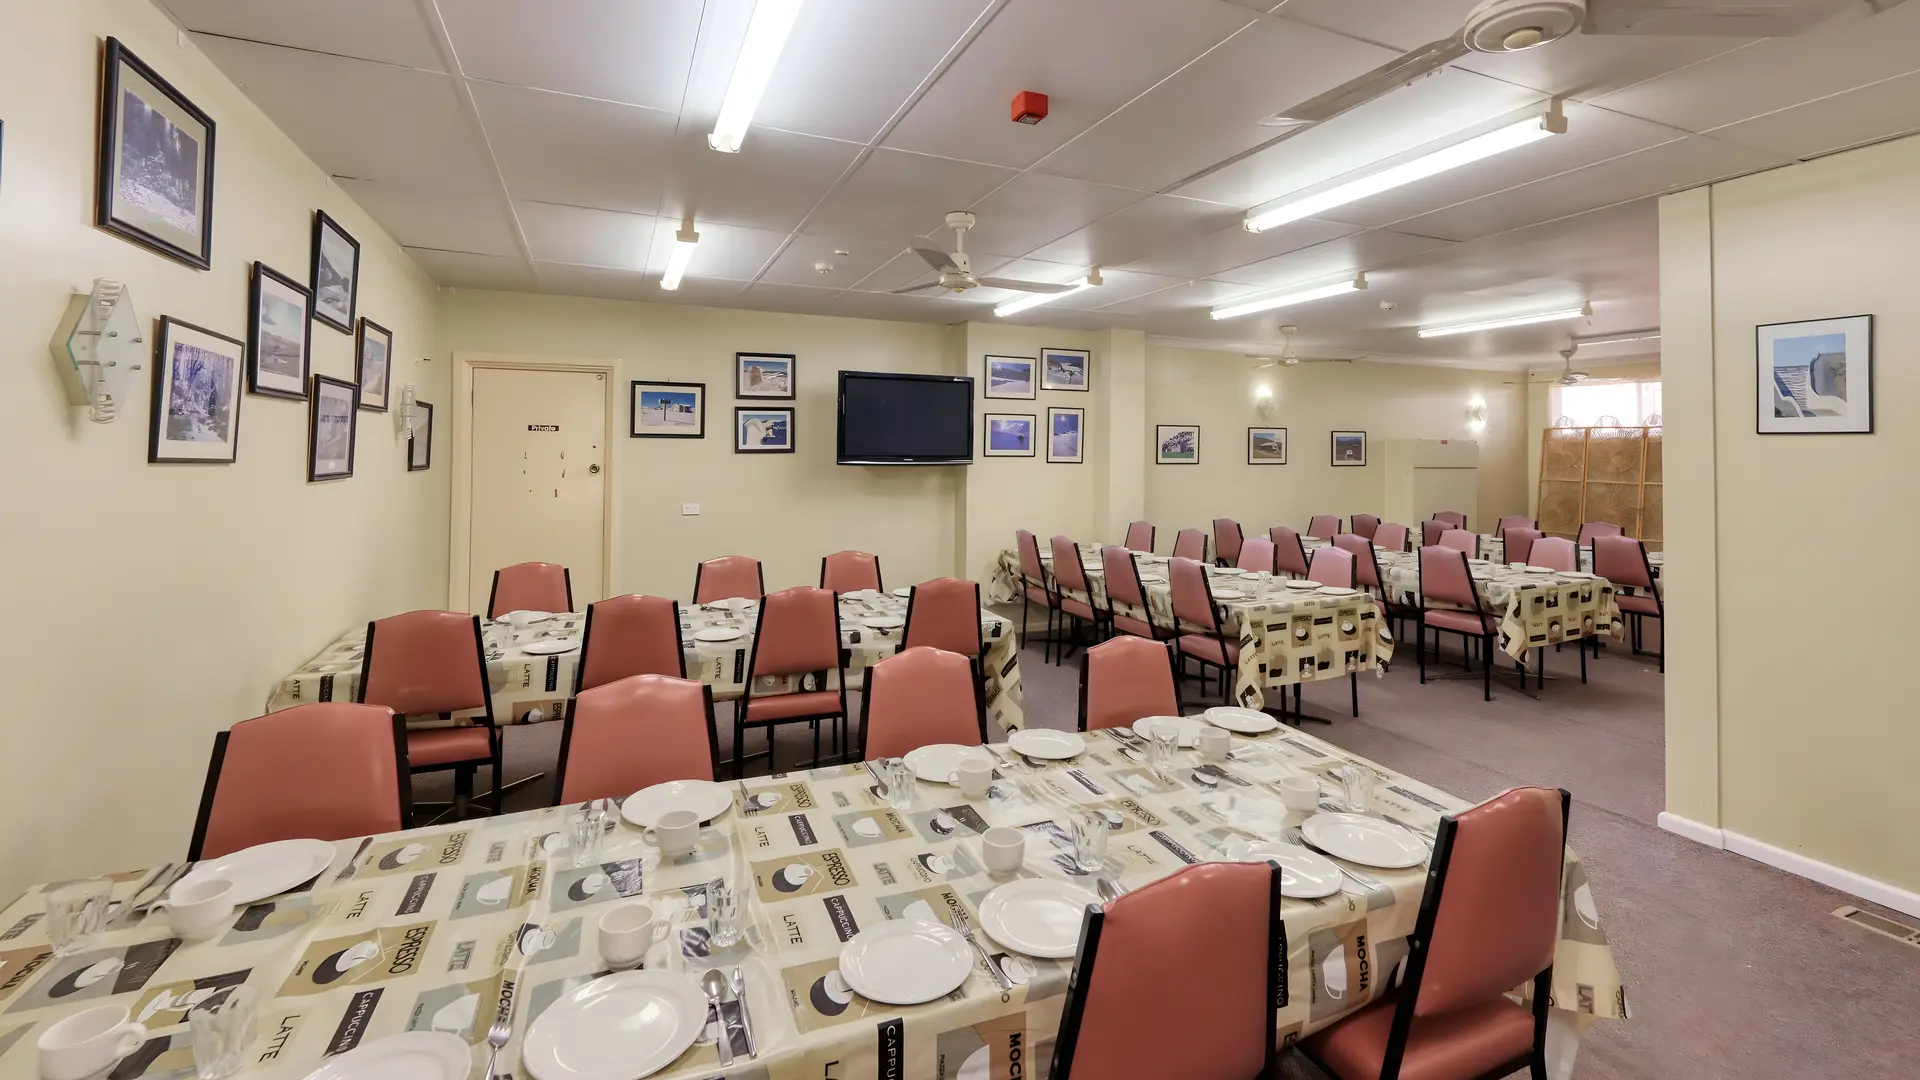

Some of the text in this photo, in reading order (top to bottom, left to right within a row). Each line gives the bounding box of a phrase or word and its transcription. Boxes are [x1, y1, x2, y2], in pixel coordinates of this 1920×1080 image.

[293, 679, 301, 700] ATTE
[522, 663, 531, 688] LATTE
[755, 826, 770, 848] LATTE
[822, 852, 851, 886] ESPRESSO
[346, 890, 374, 919] LATTE
[783, 914, 804, 944] LATTE
[388, 926, 429, 974] ESPRESSO
[1356, 935, 1369, 993] MOCHA
[258, 1014, 301, 1063] LATTE
[886, 1025, 897, 1080] CAPPU
[1009, 1032, 1022, 1080] MOC
